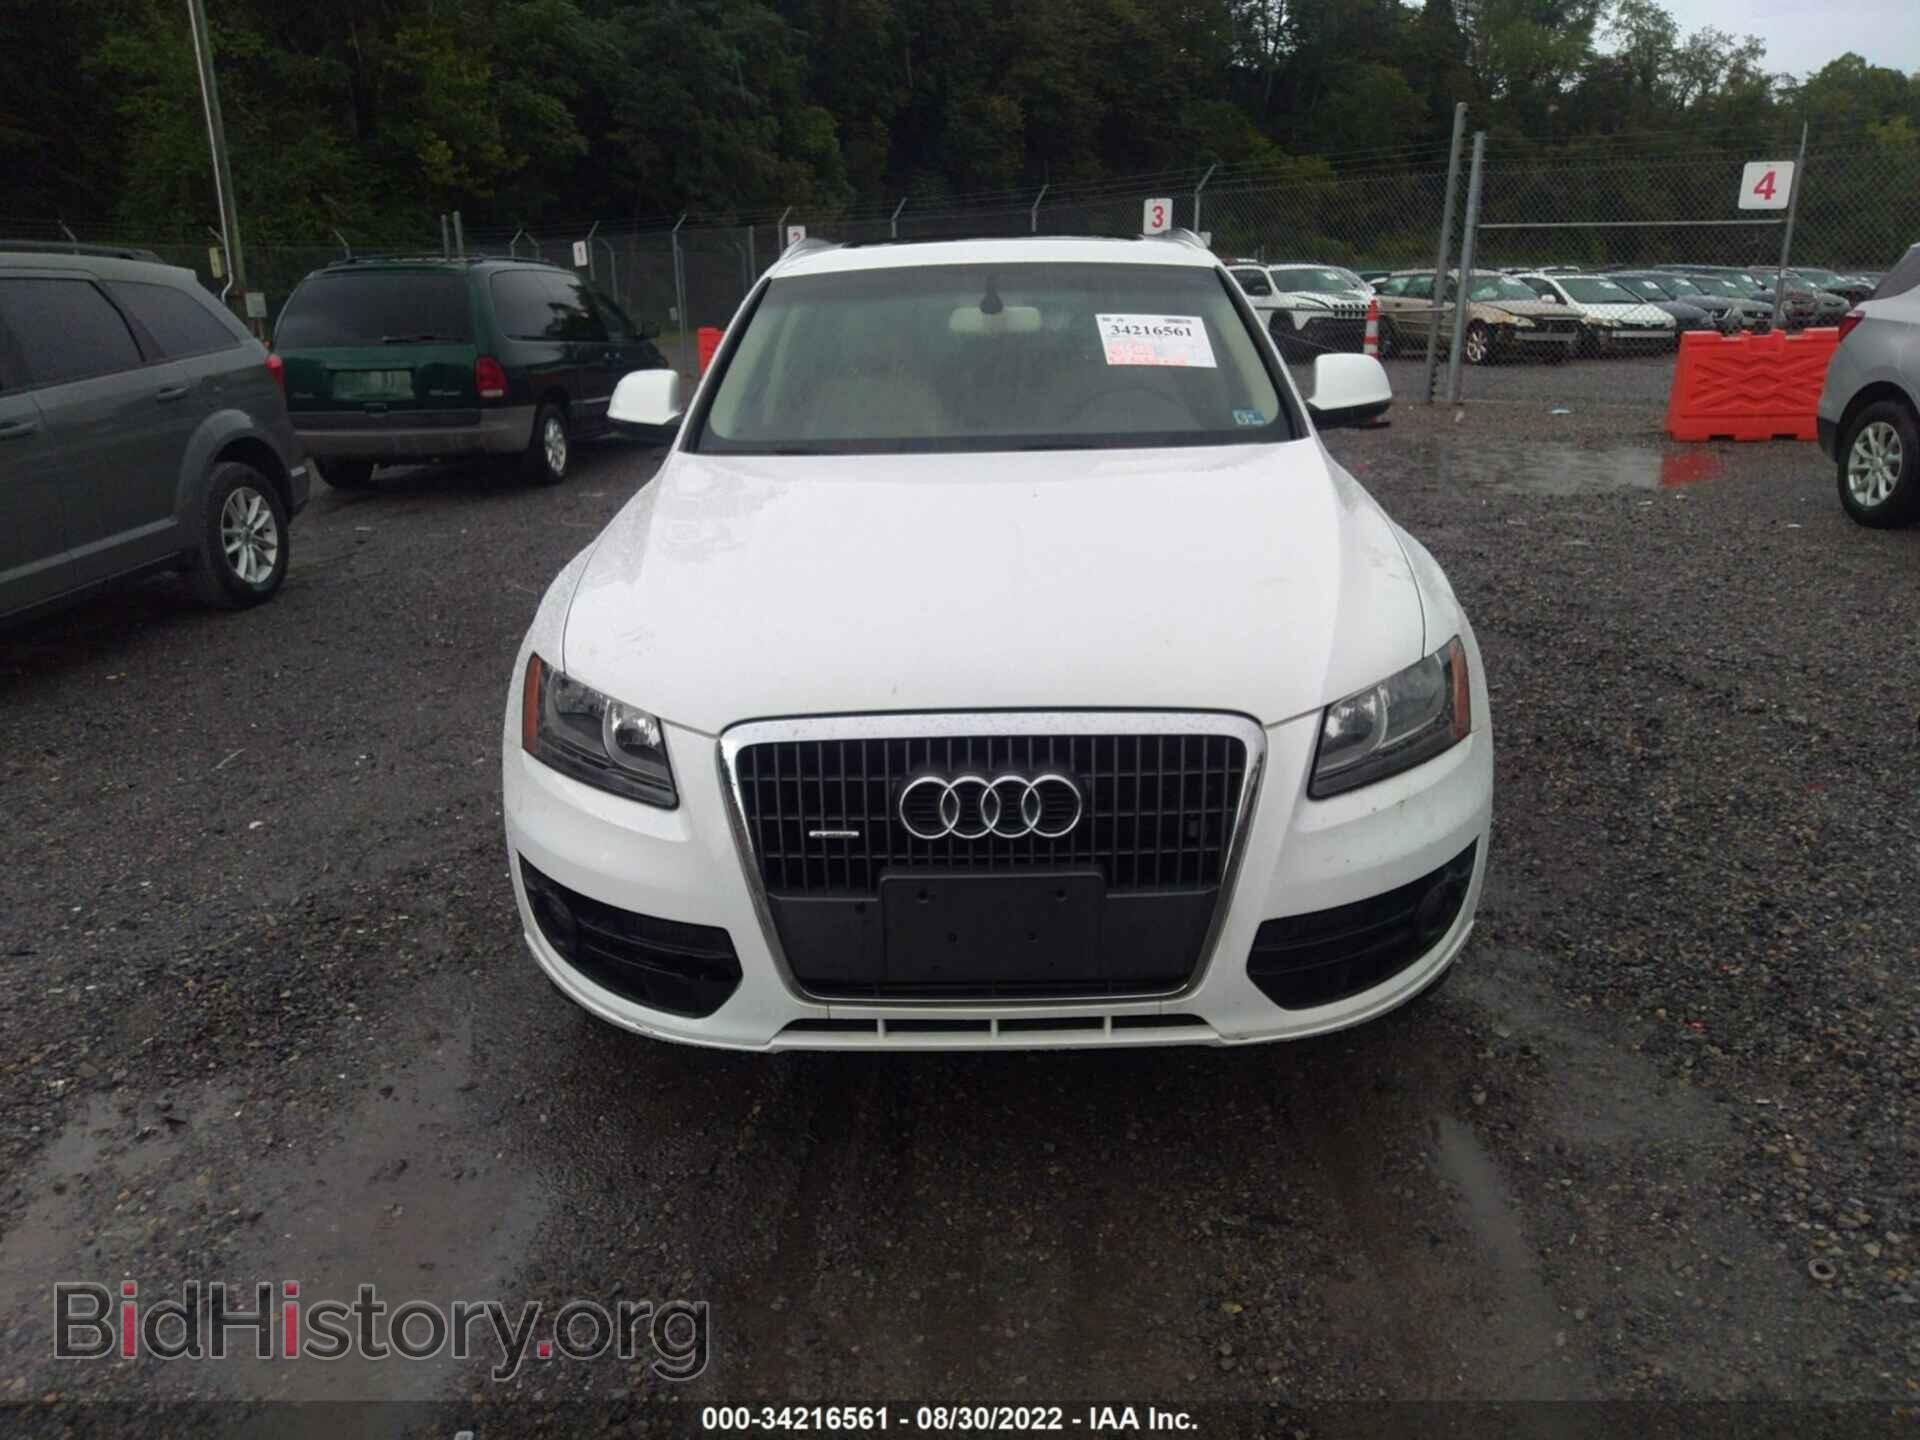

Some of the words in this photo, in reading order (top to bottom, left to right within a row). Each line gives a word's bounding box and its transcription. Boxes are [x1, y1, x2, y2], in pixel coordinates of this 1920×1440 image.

[1753, 171, 1777, 200] 4
[1152, 206, 1164, 228] 3
[1111, 325, 1192, 337] 34216561
